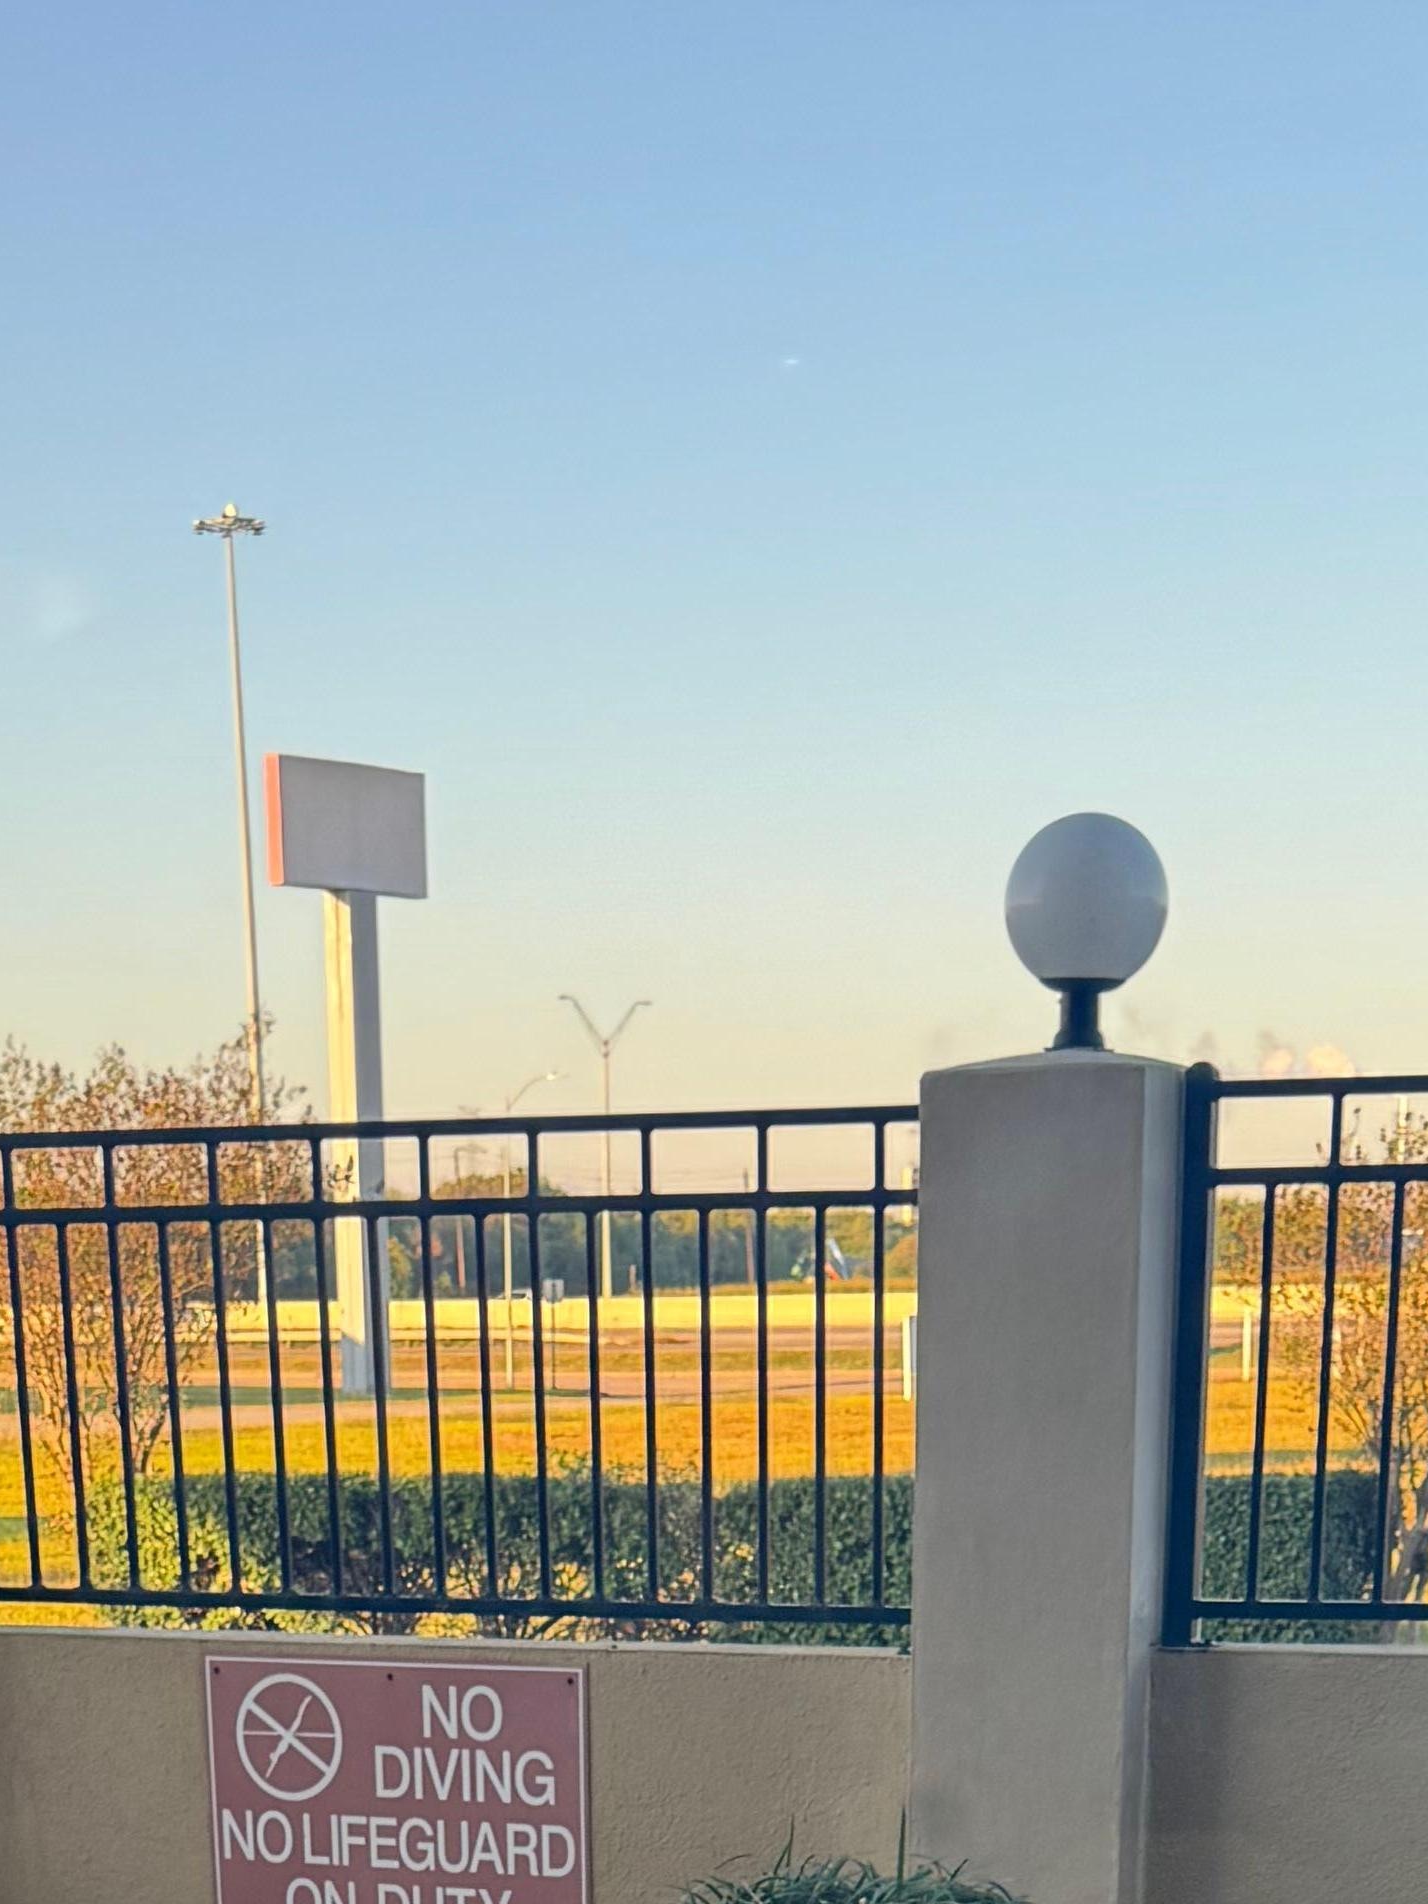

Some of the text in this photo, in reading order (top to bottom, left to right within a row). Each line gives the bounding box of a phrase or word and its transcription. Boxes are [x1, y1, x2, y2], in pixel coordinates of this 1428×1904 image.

[422, 1685, 503, 1742] NO
[374, 1745, 556, 1806] DIVING
[222, 1808, 575, 1878] NO LIFEGUARD
